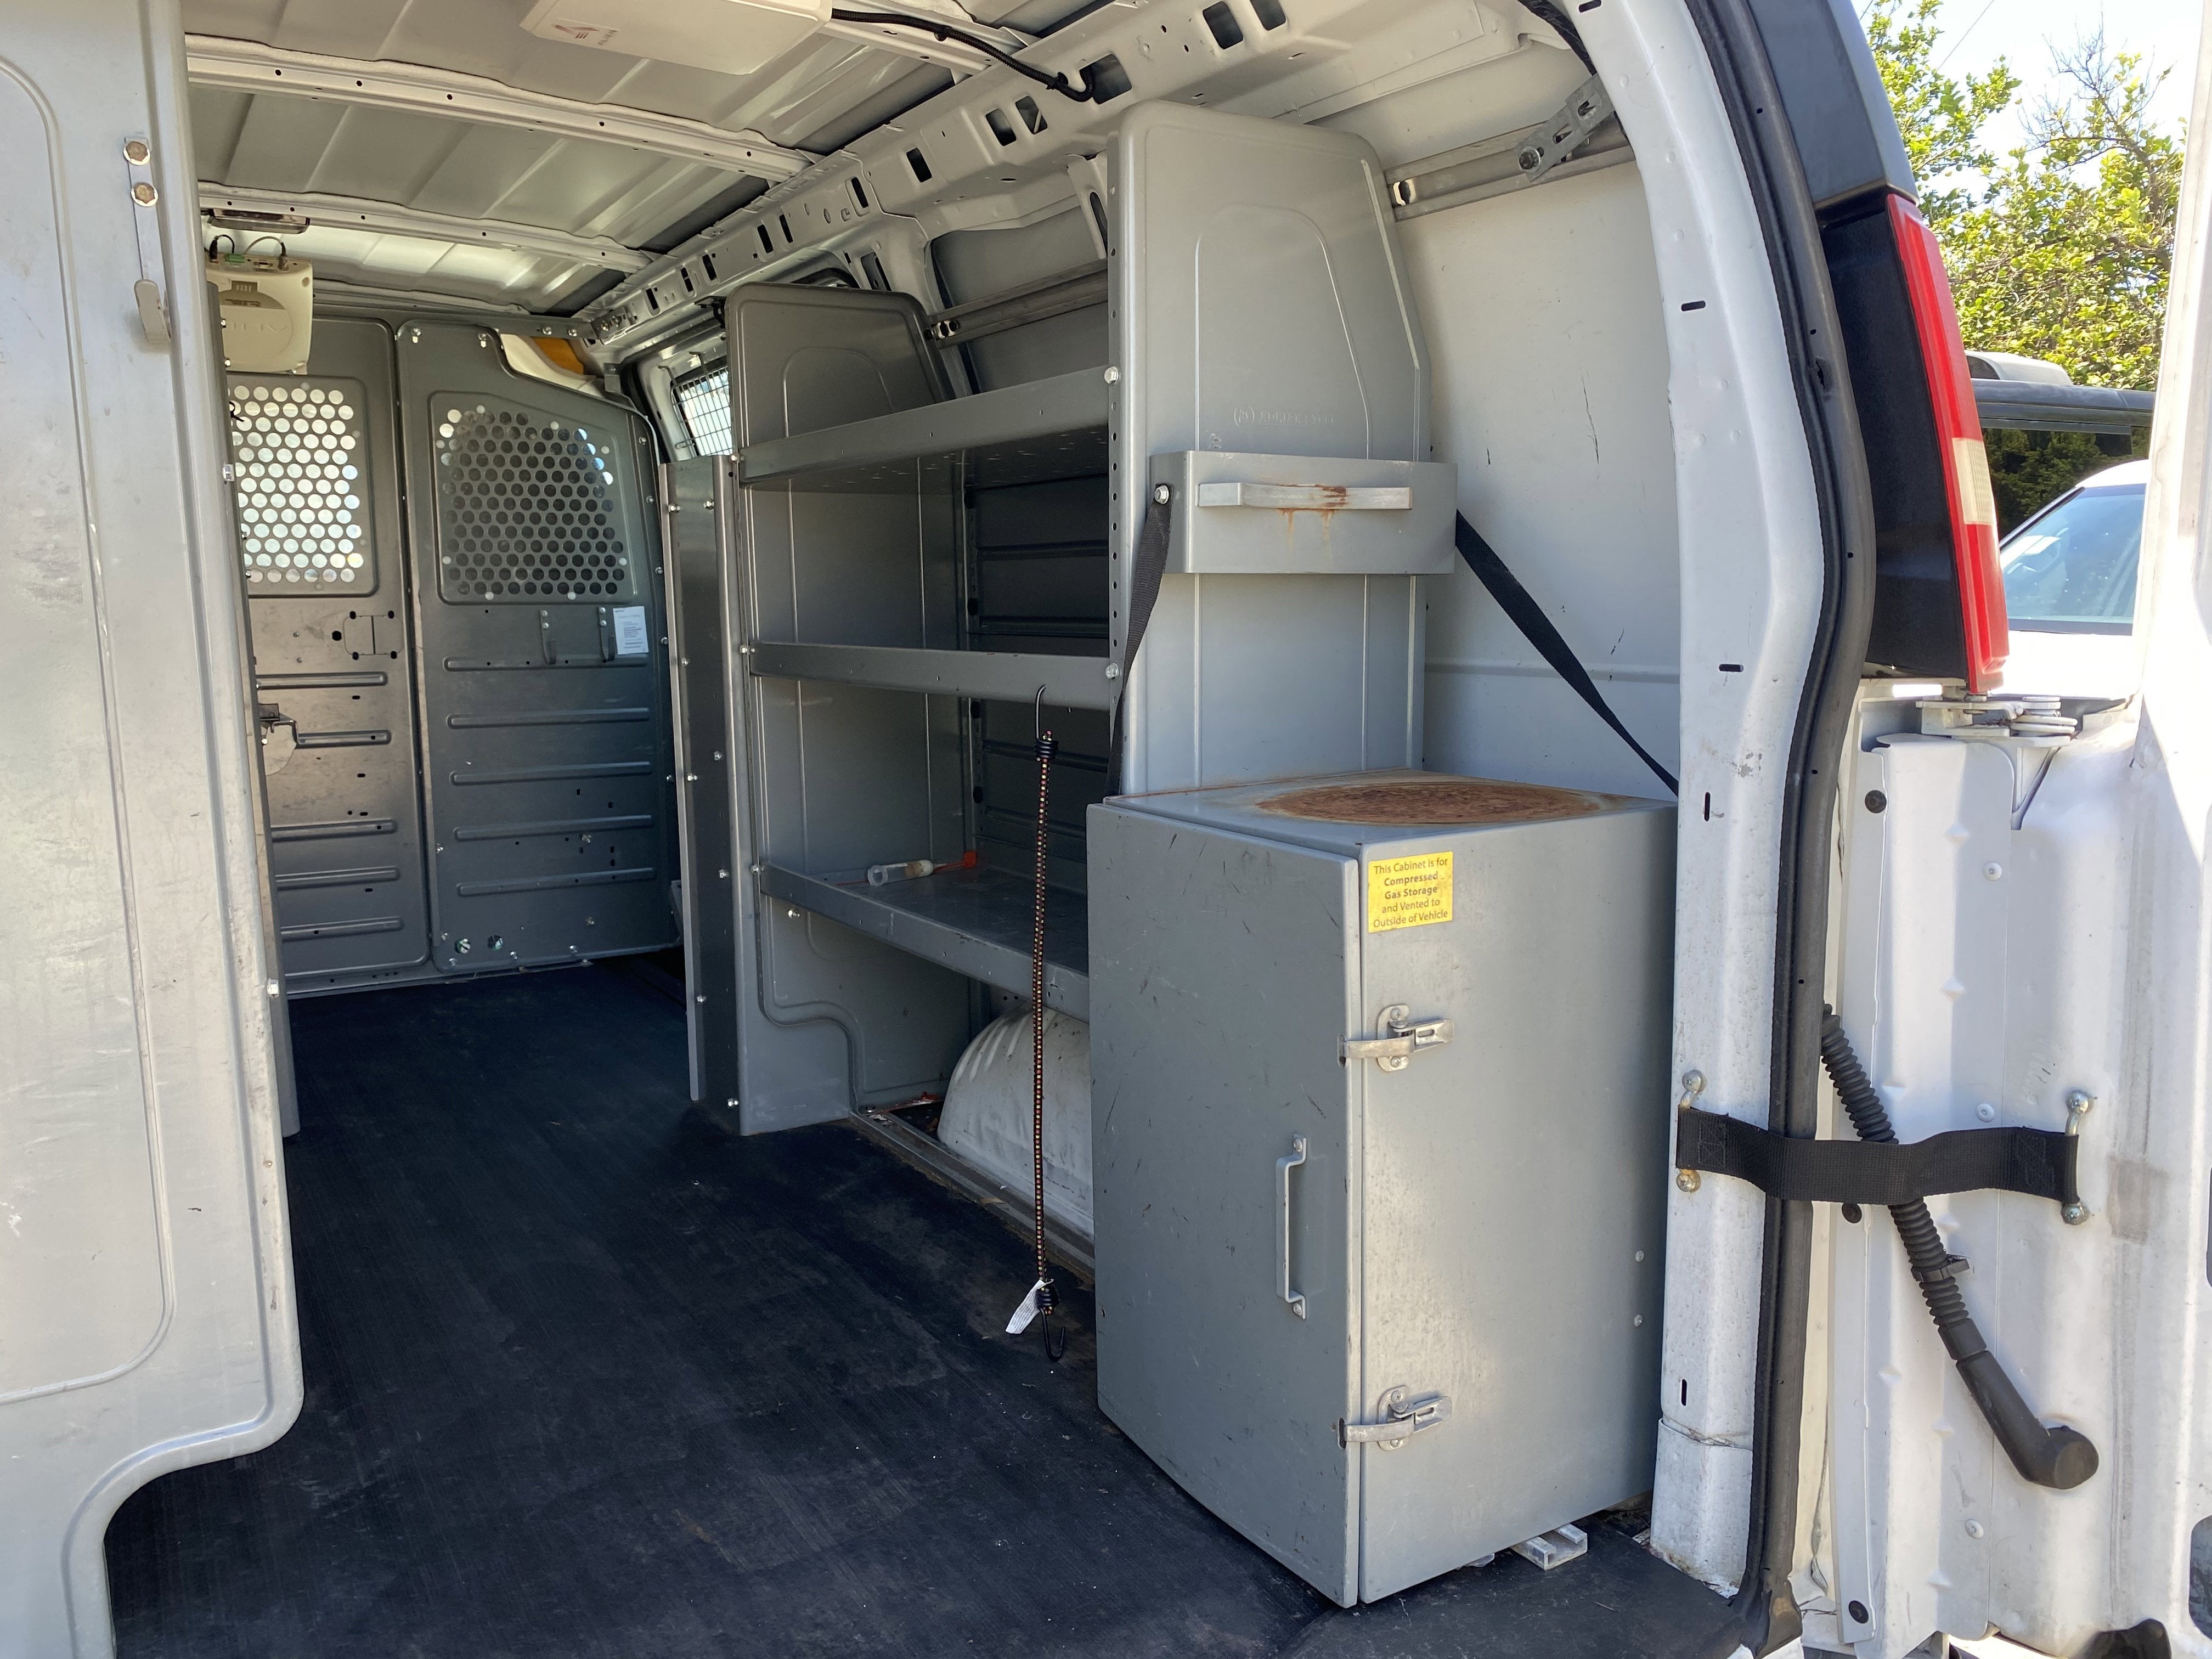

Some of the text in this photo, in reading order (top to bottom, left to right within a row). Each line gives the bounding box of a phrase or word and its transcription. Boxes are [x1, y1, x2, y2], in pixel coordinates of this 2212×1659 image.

[1374, 865, 1391, 874] This
[1393, 861, 1426, 872] Cabinet
[1436, 857, 1448, 866] for
[1384, 871, 1438, 886] Compressed
[1385, 886, 1438, 900] Gas Storage
[1382, 899, 1440, 913] and Vented to
[1373, 910, 1448, 928] Outside of Vehicle
